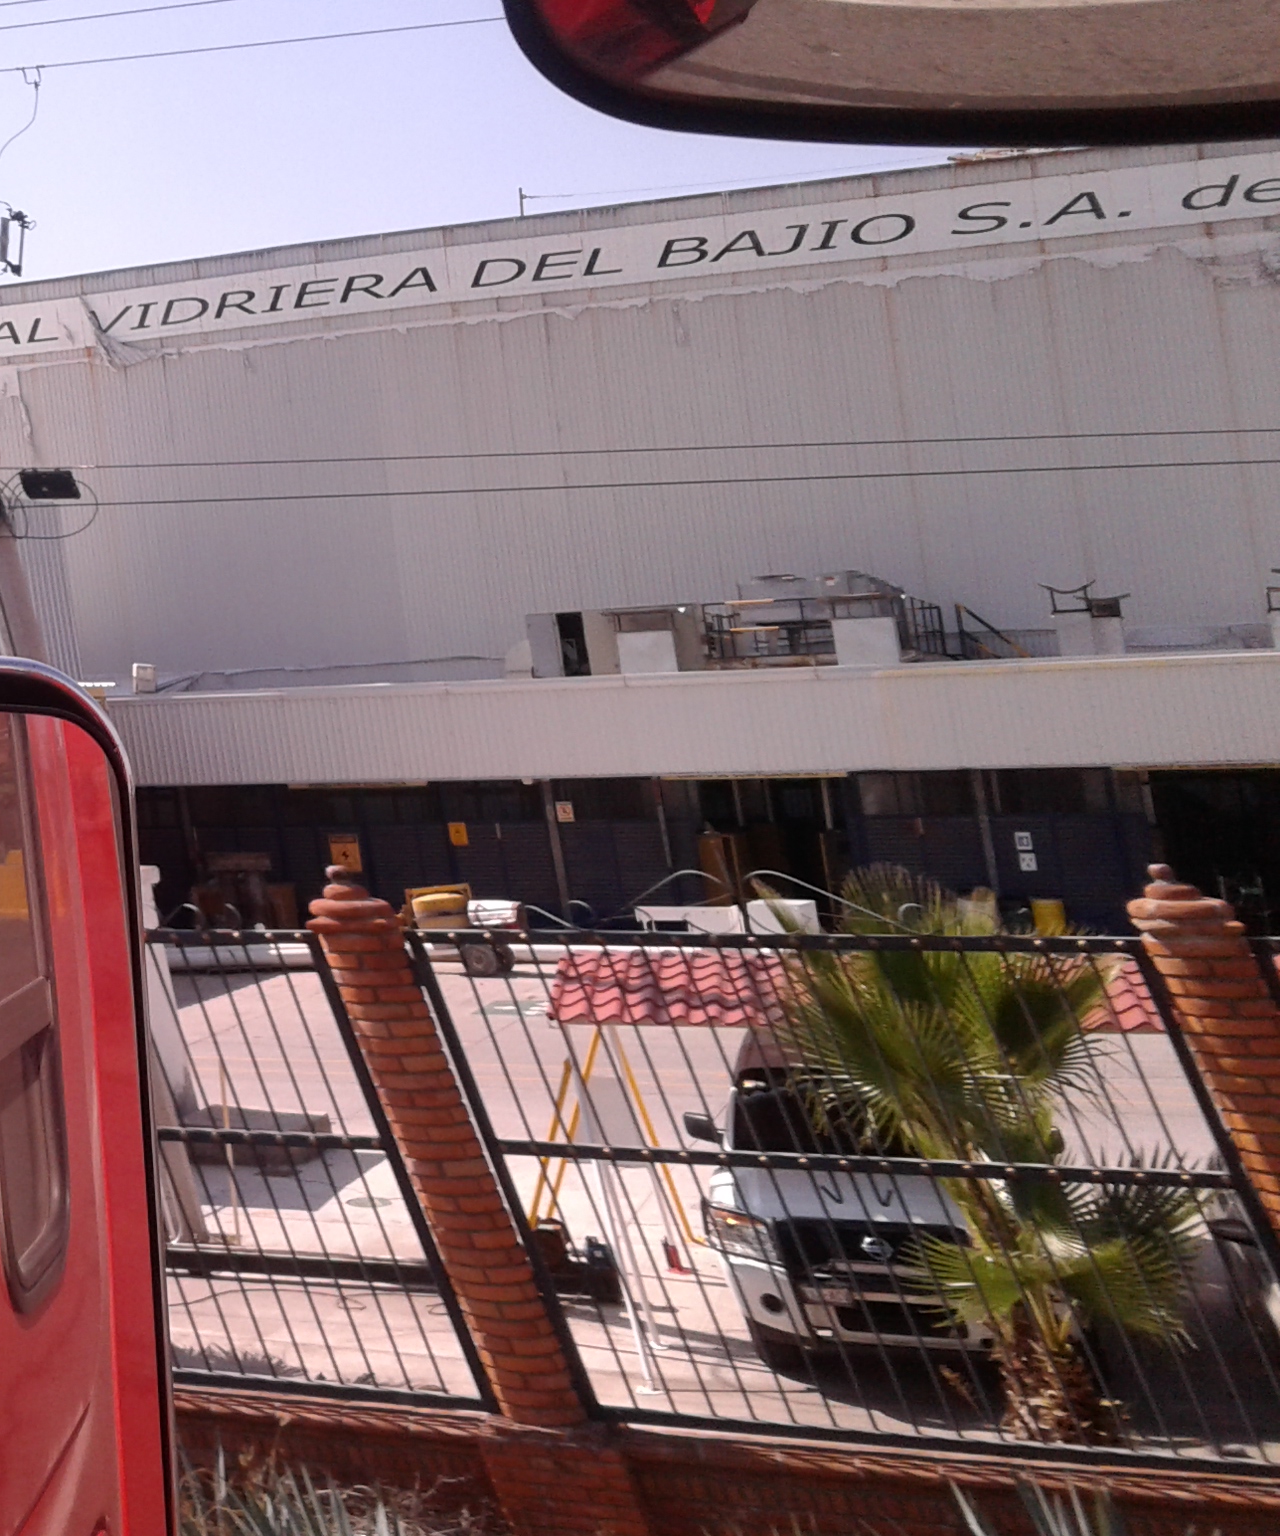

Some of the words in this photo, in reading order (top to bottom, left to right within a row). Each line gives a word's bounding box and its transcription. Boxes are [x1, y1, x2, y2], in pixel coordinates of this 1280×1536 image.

[91, 266, 437, 334] VIDRIERA
[470, 248, 622, 288] DEL
[655, 213, 915, 268] BAJIO
[950, 190, 1132, 235] S.A.
